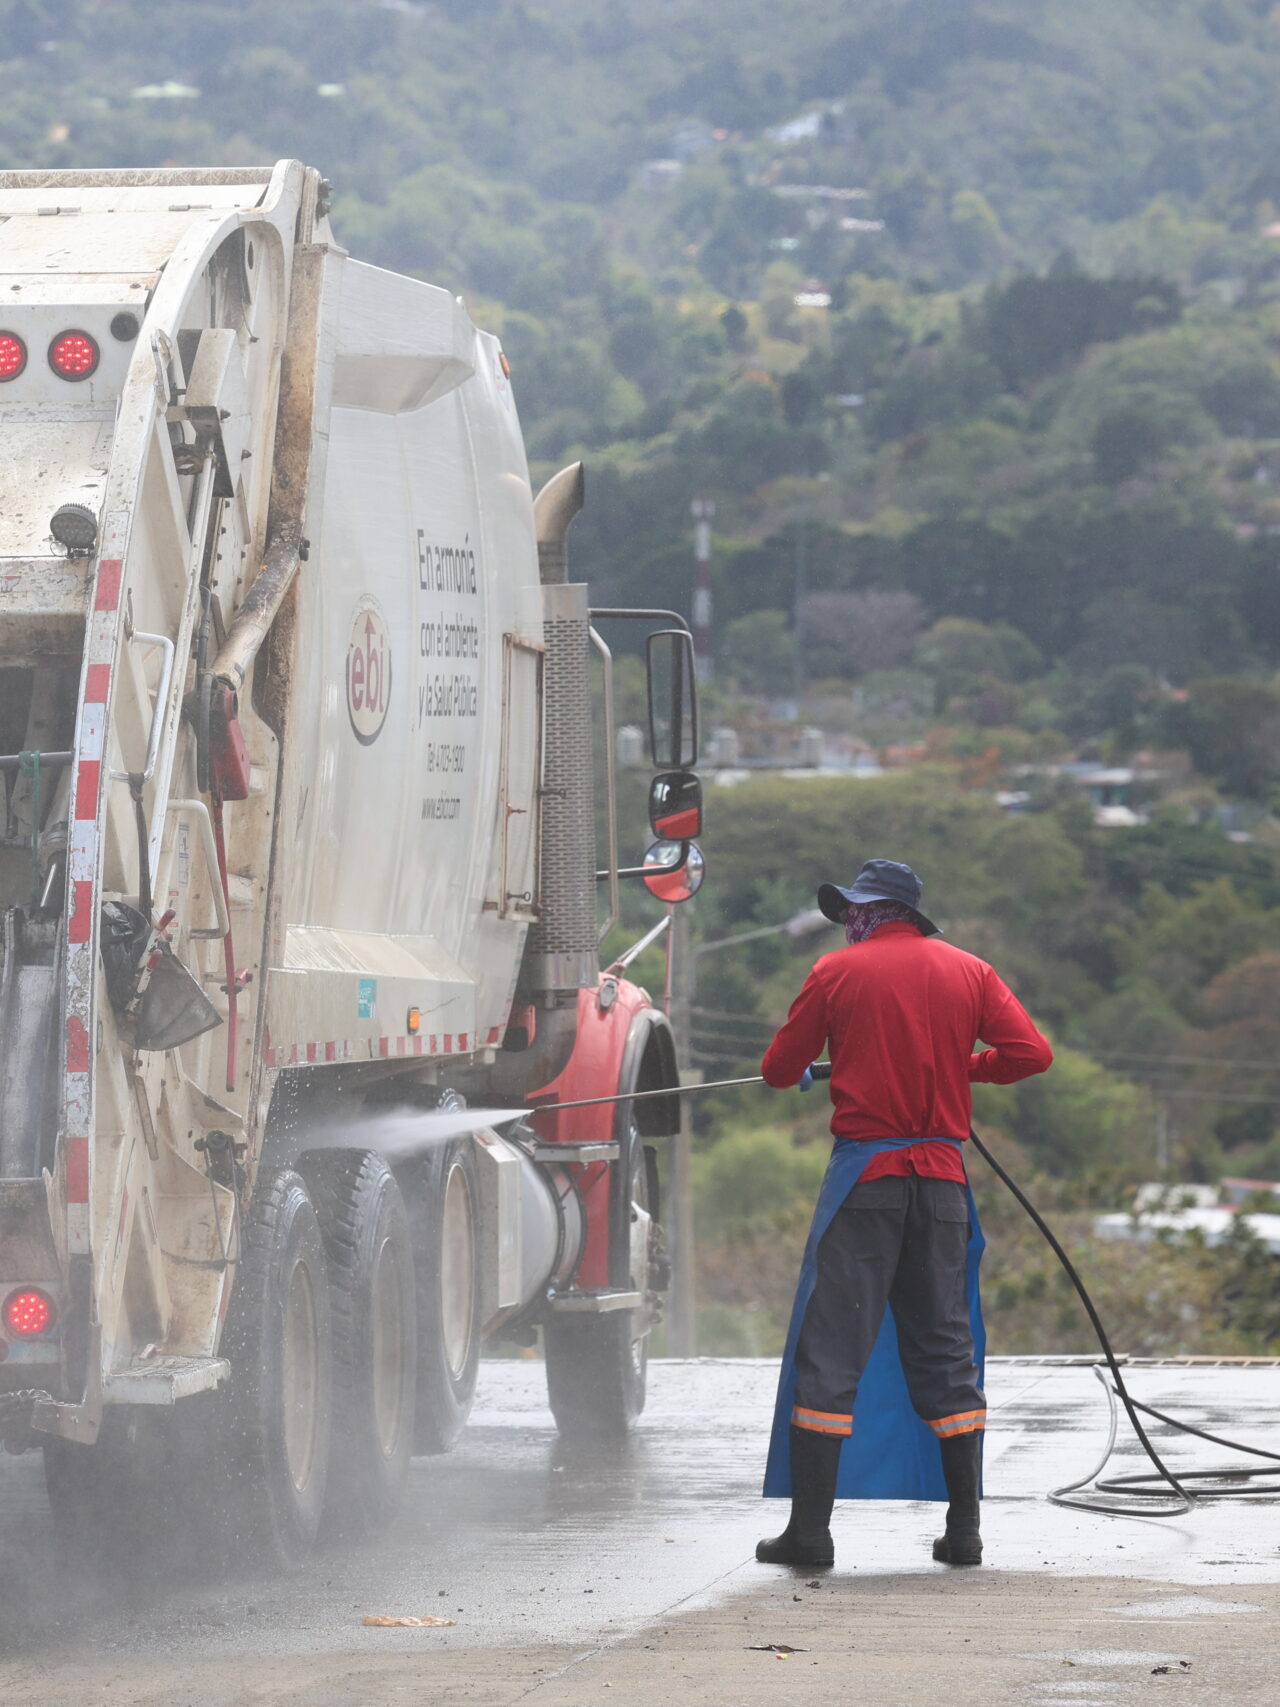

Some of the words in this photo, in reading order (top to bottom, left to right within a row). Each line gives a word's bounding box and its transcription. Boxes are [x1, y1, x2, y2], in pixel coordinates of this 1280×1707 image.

[417, 529, 434, 592] En
[435, 532, 477, 595] armonía
[420, 621, 436, 657] con
[437, 611, 444, 657] el
[445, 612, 479, 659] ambiente
[418, 684, 425, 729] y
[425, 673, 433, 717] la
[433, 672, 453, 717] Salud
